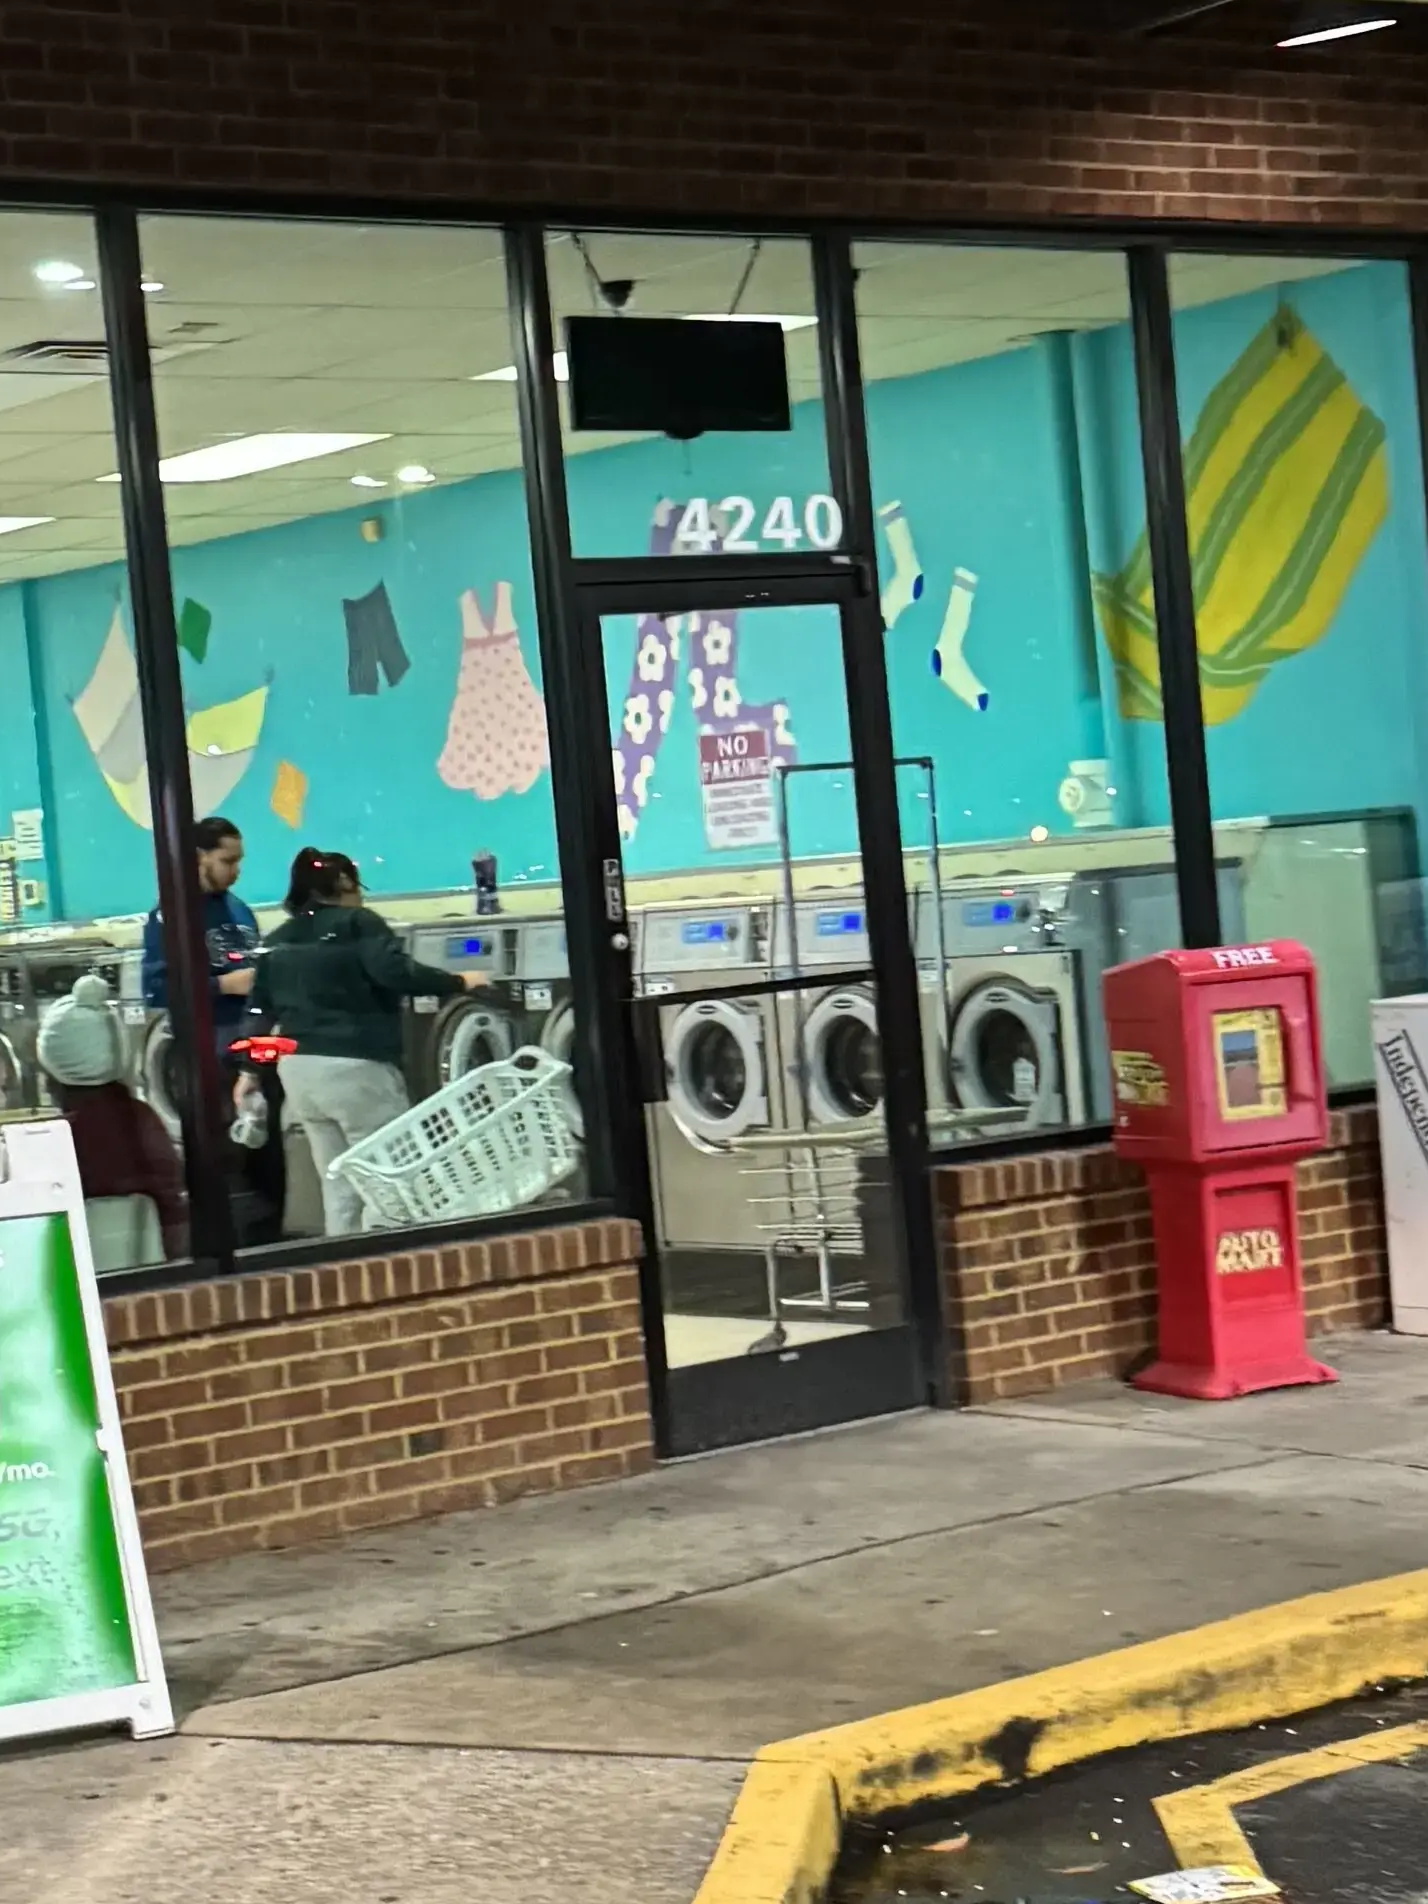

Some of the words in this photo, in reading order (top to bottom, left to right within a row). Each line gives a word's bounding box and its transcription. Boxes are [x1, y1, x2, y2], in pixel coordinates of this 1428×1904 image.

[676, 494, 843, 551] 4240
[716, 734, 749, 758] NO
[1212, 947, 1280, 970] FREE
